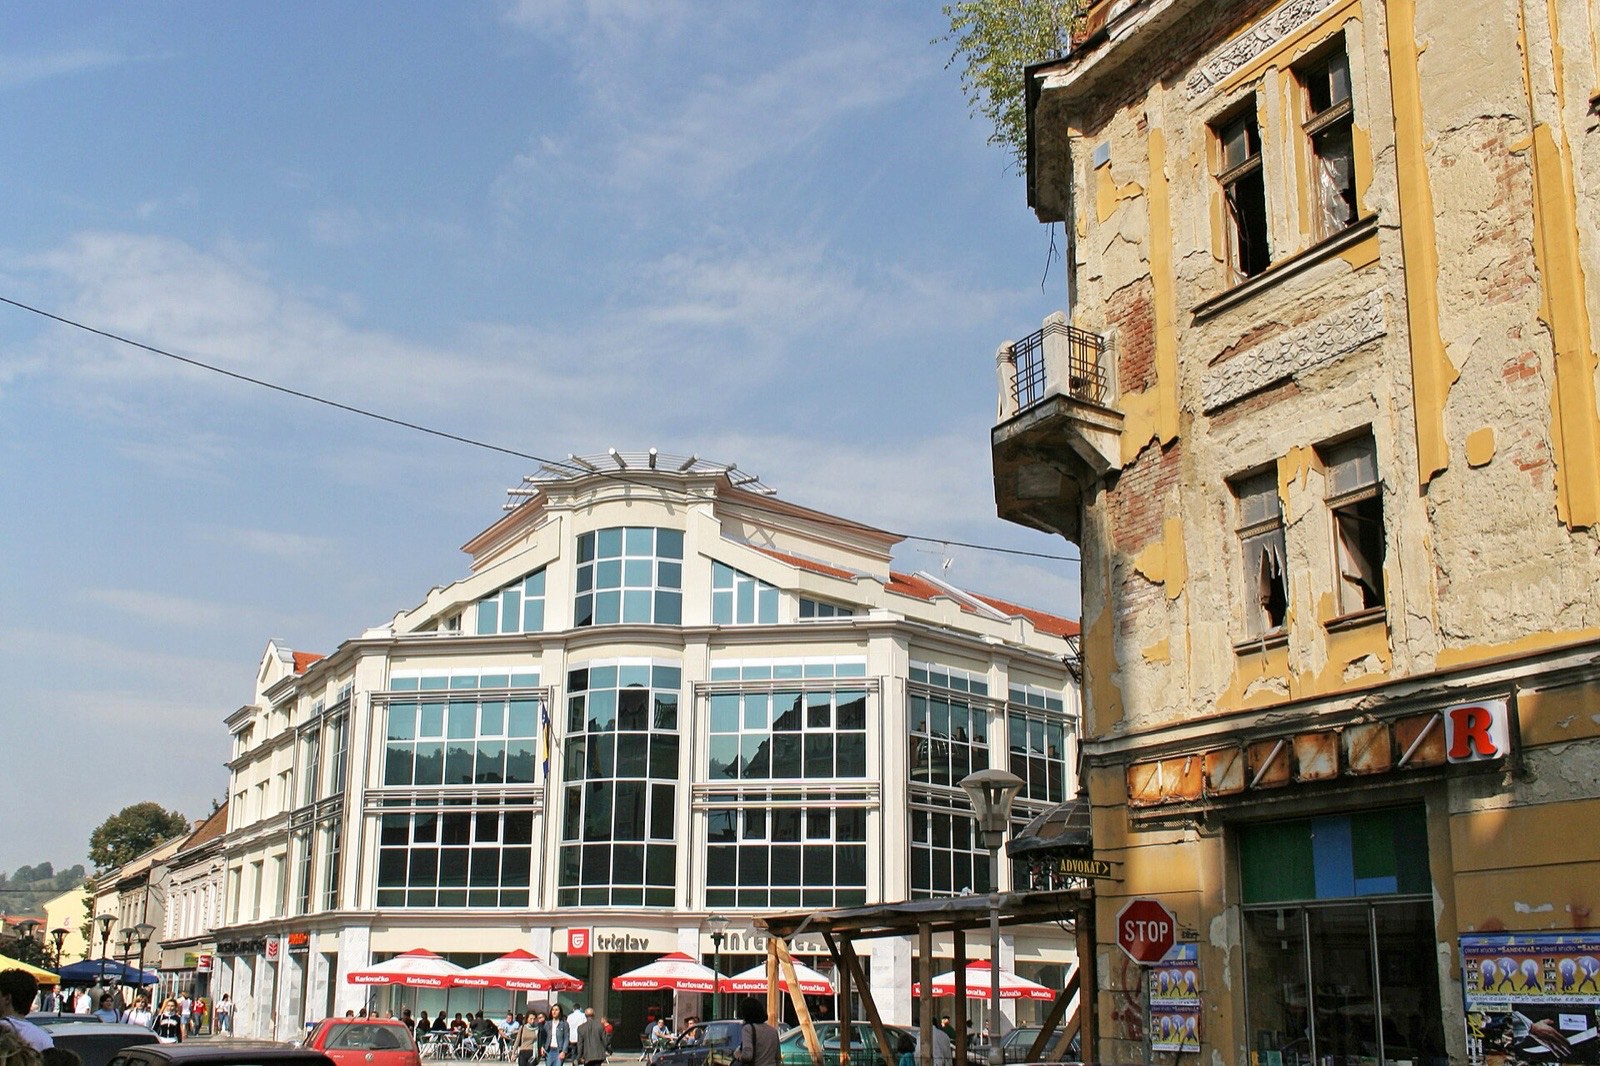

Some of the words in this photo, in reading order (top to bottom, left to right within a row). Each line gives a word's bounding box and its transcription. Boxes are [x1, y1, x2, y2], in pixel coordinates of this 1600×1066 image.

[1449, 706, 1498, 760] R
[1060, 859, 1100, 874] ADVOKAT
[1124, 920, 1169, 943] STOP
[597, 933, 650, 952] triglav
[354, 975, 390, 983] Karlovačko
[406, 976, 442, 986] Karlovačko
[453, 977, 489, 986] Karlovačko
[506, 979, 542, 989] Karlovačko
[622, 980, 659, 988] Karlovačko
[676, 980, 714, 990] Karlovačko
